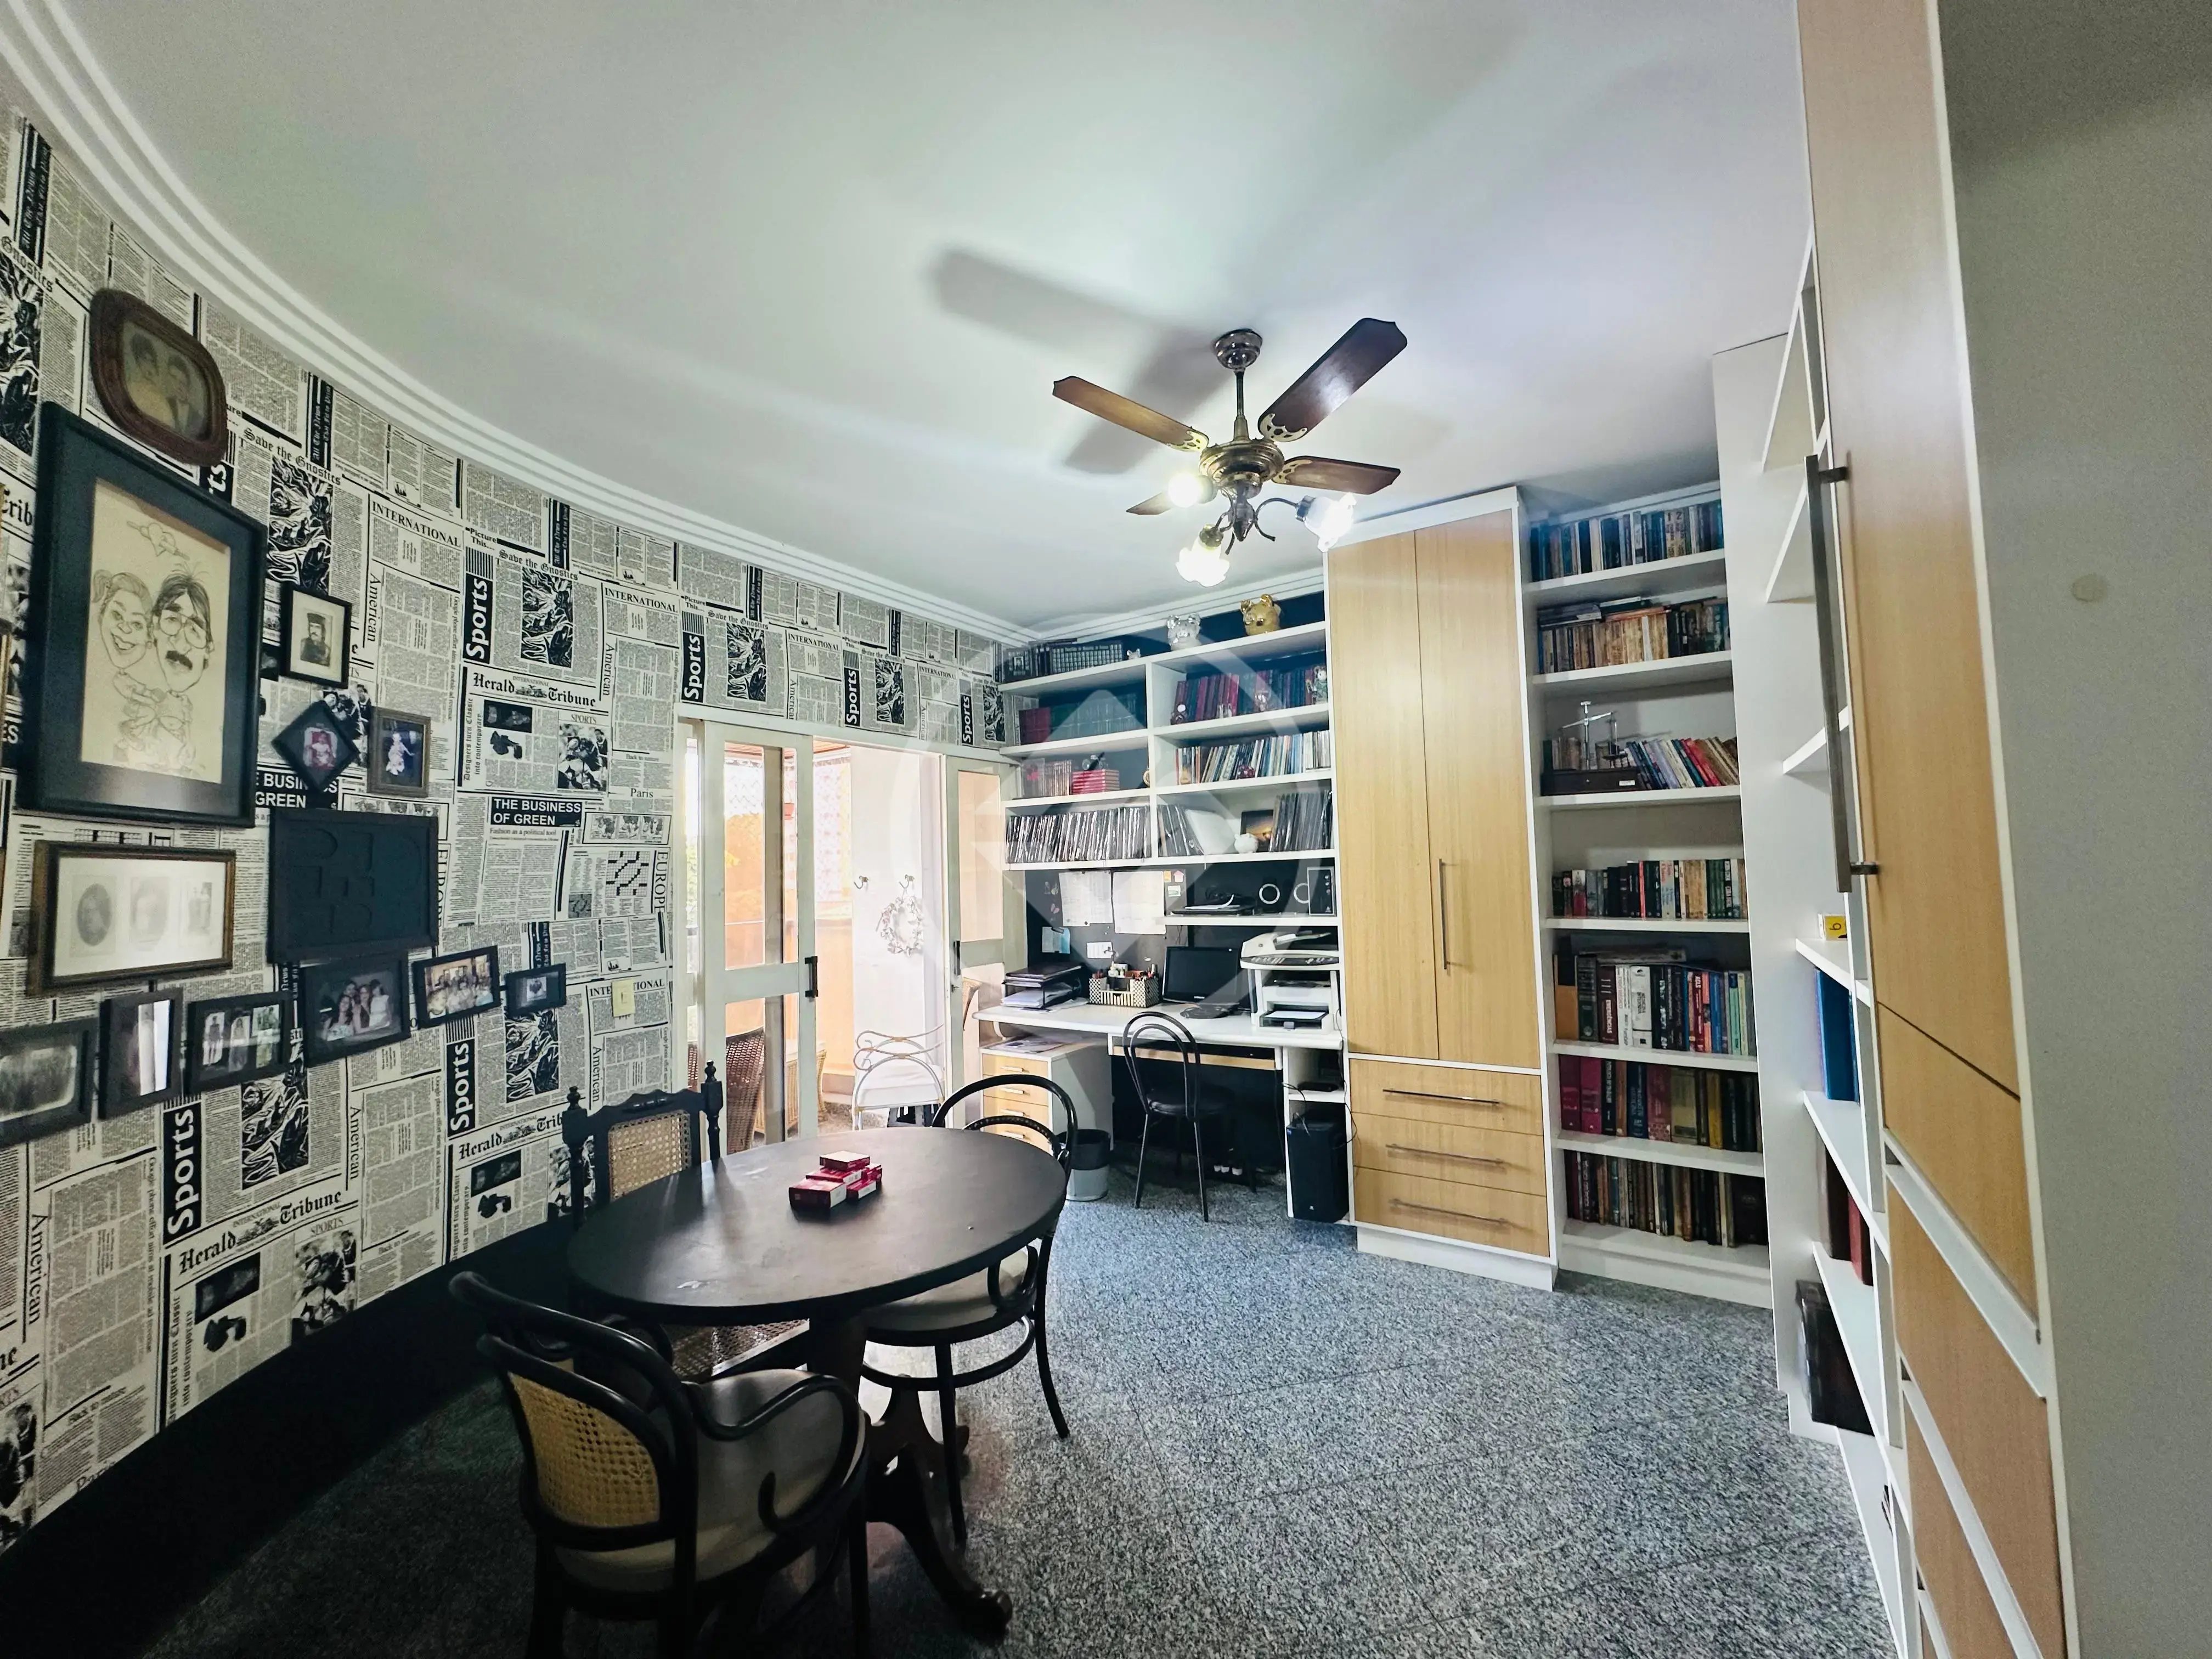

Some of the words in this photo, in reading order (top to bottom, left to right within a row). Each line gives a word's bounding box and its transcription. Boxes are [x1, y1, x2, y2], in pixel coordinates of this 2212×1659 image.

[244, 427, 273, 452] Save
[277, 444, 292, 462] the
[296, 455, 341, 486] Gnostics
[372, 500, 461, 548] INTERNATIONAL
[470, 527, 497, 544] Picture
[499, 549, 523, 565] Save
[526, 558, 538, 569] the
[540, 562, 578, 580] Gnostics
[367, 573, 382, 642] American
[466, 578, 489, 659] Sports
[604, 588, 678, 612] INTERNATIONAL
[708, 610, 727, 620] Save
[729, 614, 738, 623] the
[788, 633, 840, 651] INTERNATIONAL
[473, 672, 515, 693] Herald
[548, 687, 596, 707] Tribune
[603, 643, 614, 696] American
[684, 635, 703, 700] Sports
[919, 665, 956, 680] INTERNATIONAL
[571, 714, 596, 724] SPORTS
[846, 669, 859, 725] Sports
[962, 695, 972, 743] Sports
[255, 791, 306, 808] GREEN
[494, 798, 518, 810] THE
[522, 799, 581, 813] BUSINESS
[630, 788, 653, 798] Paris
[493, 812, 510, 823] OF
[514, 814, 556, 826] GREEN
[450, 1042, 474, 1131] Sports
[592, 1046, 602, 1102] American
[349, 1106, 363, 1180] American
[459, 1132, 503, 1160] Herald
[536, 1113, 563, 1132] Trib
[167, 1109, 199, 1235] Sports
[179, 1231, 237, 1275] Herald
[280, 1191, 341, 1224] Tribune
[29, 1214, 48, 1325] American
